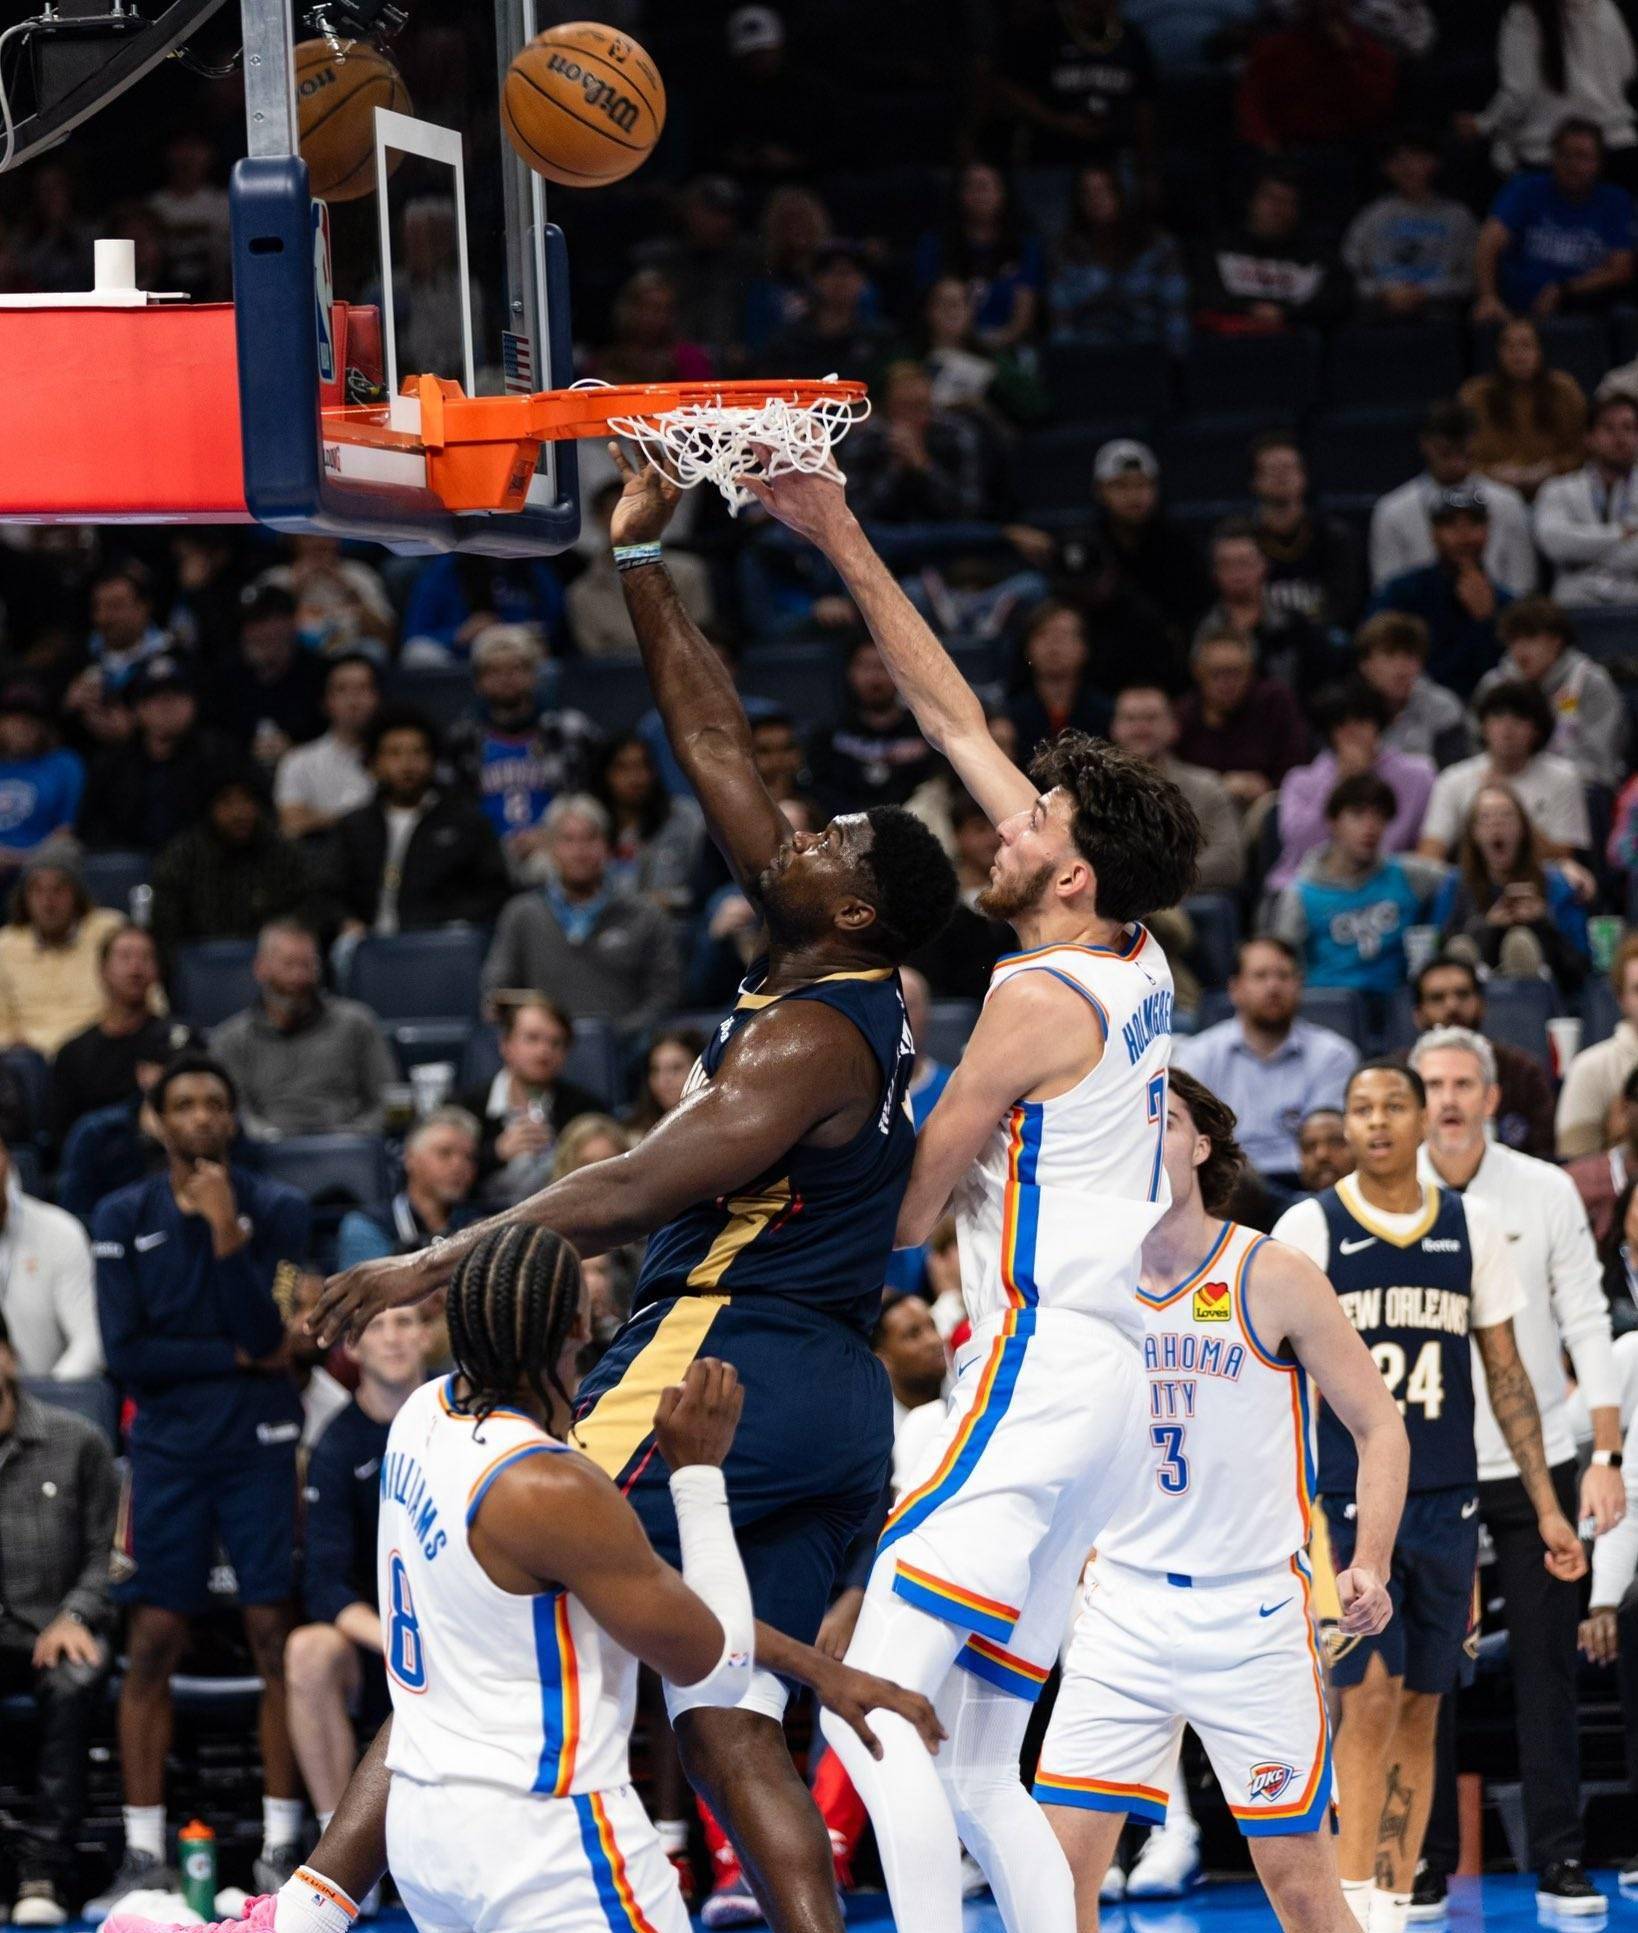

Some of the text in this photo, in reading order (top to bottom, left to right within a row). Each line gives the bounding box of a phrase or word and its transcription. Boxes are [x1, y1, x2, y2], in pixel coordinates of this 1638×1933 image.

[547, 53, 640, 134] Wilson
[1121, 989, 1174, 1066] HOLMGRE
[1146, 1068, 1168, 1202] 7
[1385, 1286, 1470, 1338] ORLEANS
[1144, 1332, 1247, 1382] AHOMA
[1150, 1379, 1197, 1418] ITY
[1149, 1423, 1191, 1496] 3
[386, 1549, 429, 1694] 8
[1250, 1768, 1284, 1794] OKC
